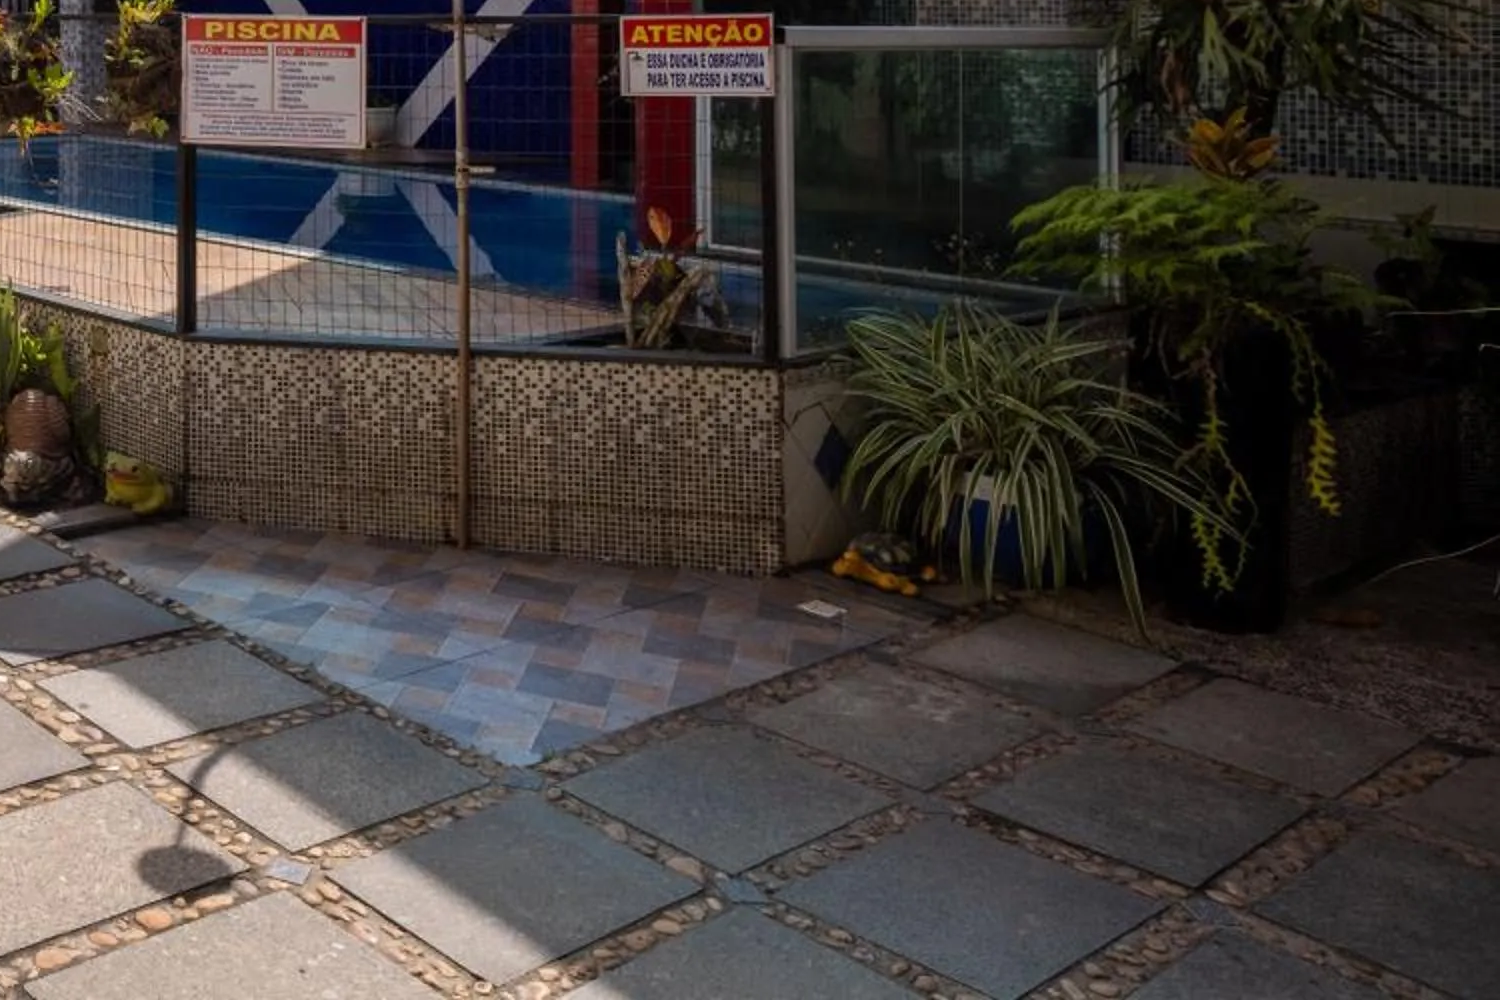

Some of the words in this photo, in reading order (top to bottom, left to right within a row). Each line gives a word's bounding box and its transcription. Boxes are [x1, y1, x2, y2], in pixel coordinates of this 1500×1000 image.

[204, 21, 341, 40] PISCINA
[631, 18, 764, 47] ATENÇÃO
[647, 52, 668, 68] ESSA
[669, 52, 699, 68] DUCHA
[647, 72, 668, 88] PARA
[670, 73, 686, 88] TER
[688, 72, 721, 88] ACESSO
[731, 72, 765, 88] PISCINA
